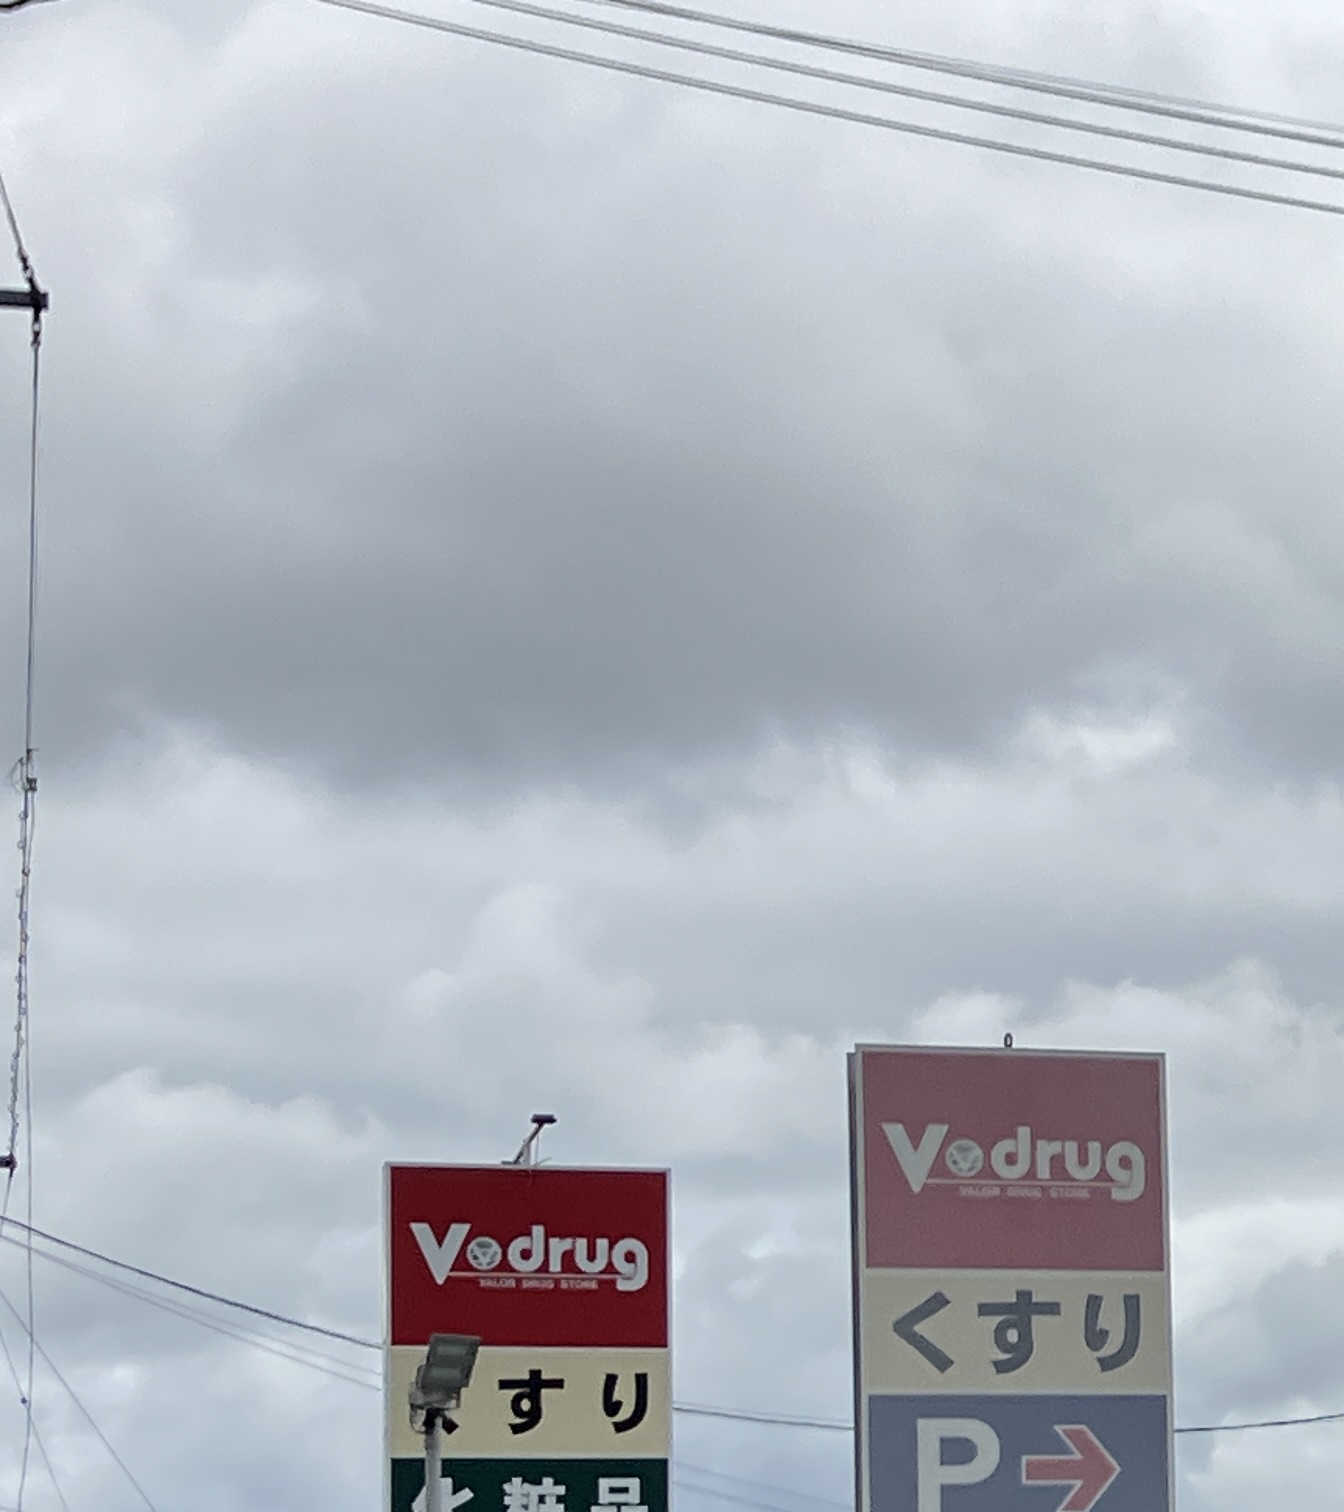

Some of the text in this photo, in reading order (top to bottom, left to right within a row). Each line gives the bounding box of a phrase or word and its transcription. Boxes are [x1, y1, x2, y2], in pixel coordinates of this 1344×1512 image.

[893, 1290, 1141, 1374] くすり
[440, 1369, 648, 1435] すり
